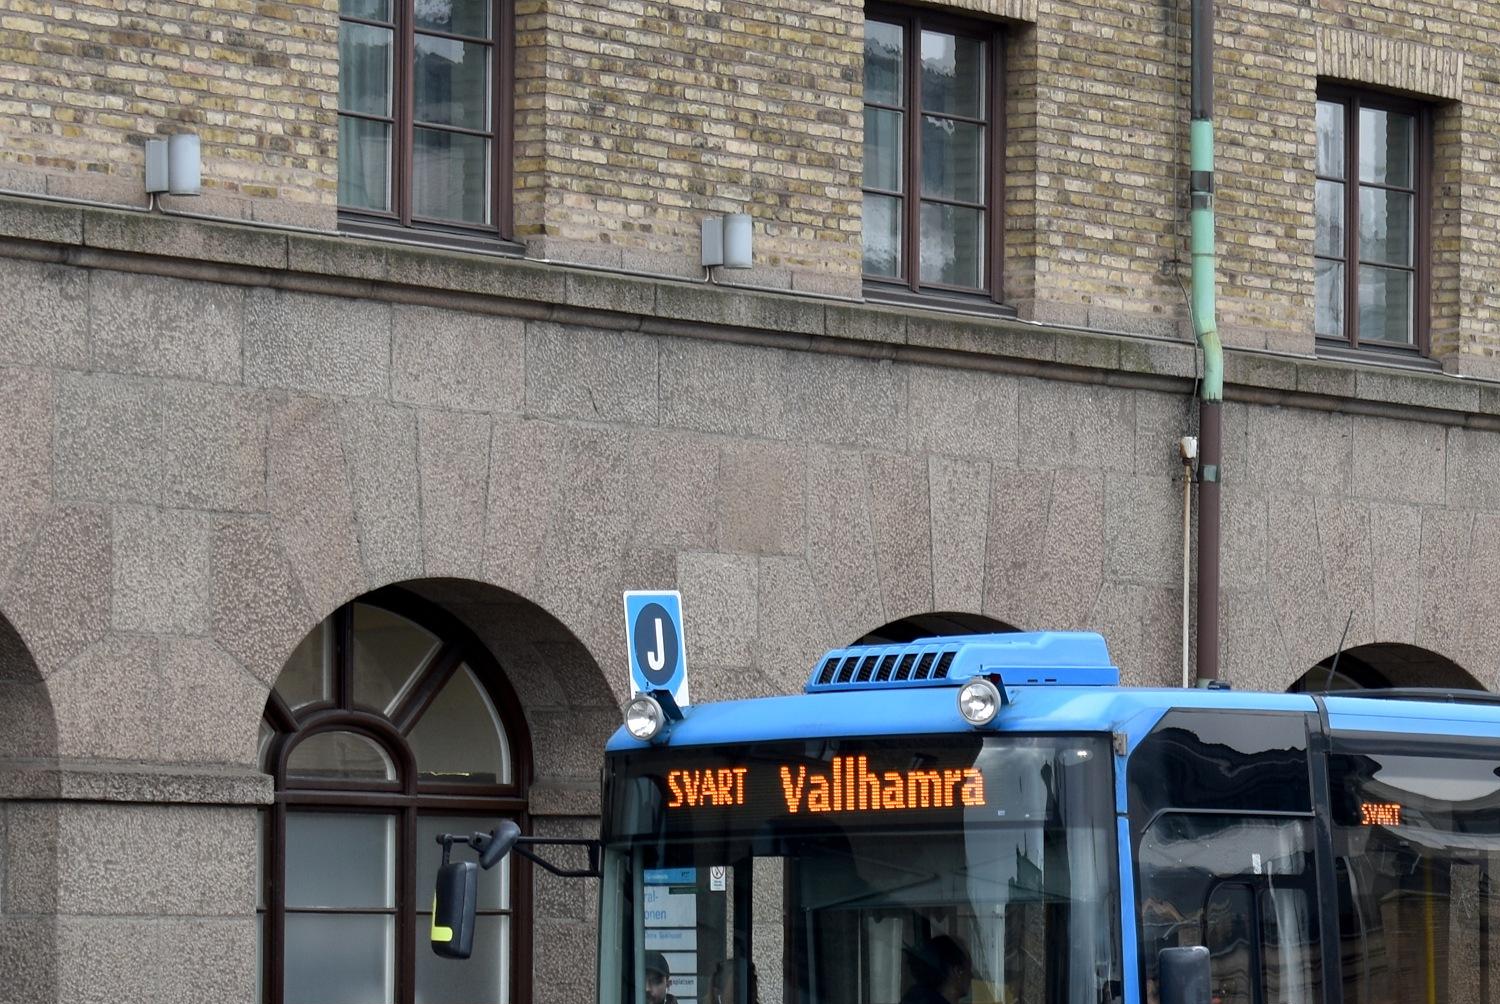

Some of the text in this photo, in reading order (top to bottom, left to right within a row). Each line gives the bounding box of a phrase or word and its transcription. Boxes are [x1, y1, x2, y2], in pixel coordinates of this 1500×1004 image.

[647, 618, 665, 671] J
[668, 755, 986, 814] SVART Vallhamra
[1361, 803, 1401, 826] SVART
